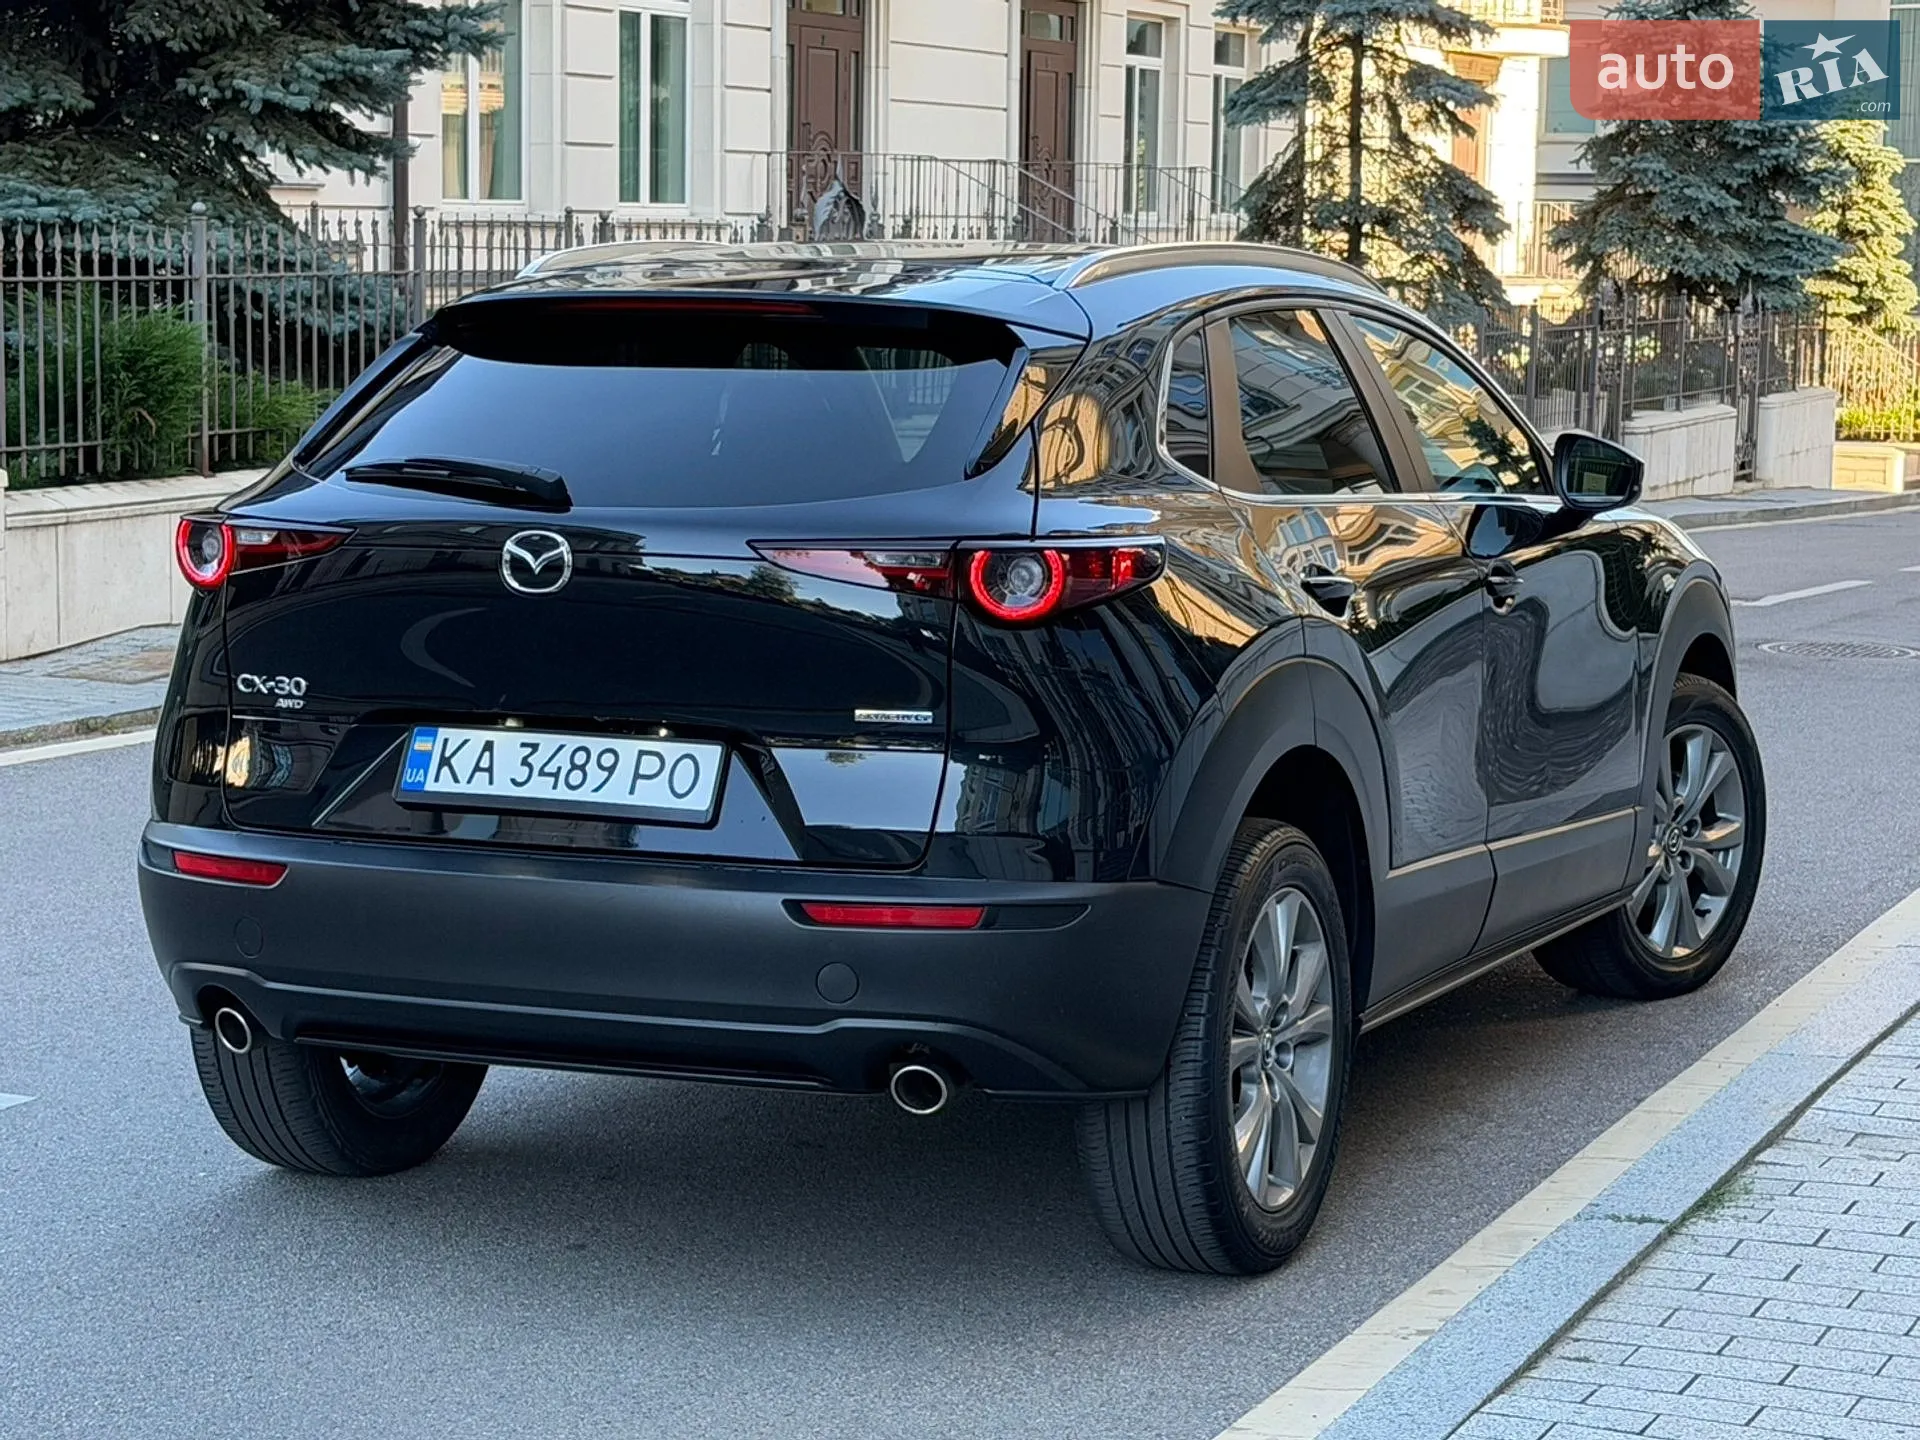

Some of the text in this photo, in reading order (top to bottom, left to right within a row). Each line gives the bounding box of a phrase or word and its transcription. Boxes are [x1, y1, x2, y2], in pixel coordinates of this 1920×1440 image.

[236, 673, 307, 697] CX-30
[275, 698, 304, 709] AWD
[406, 767, 426, 783] UA
[434, 738, 700, 800] KA 3489 PO
